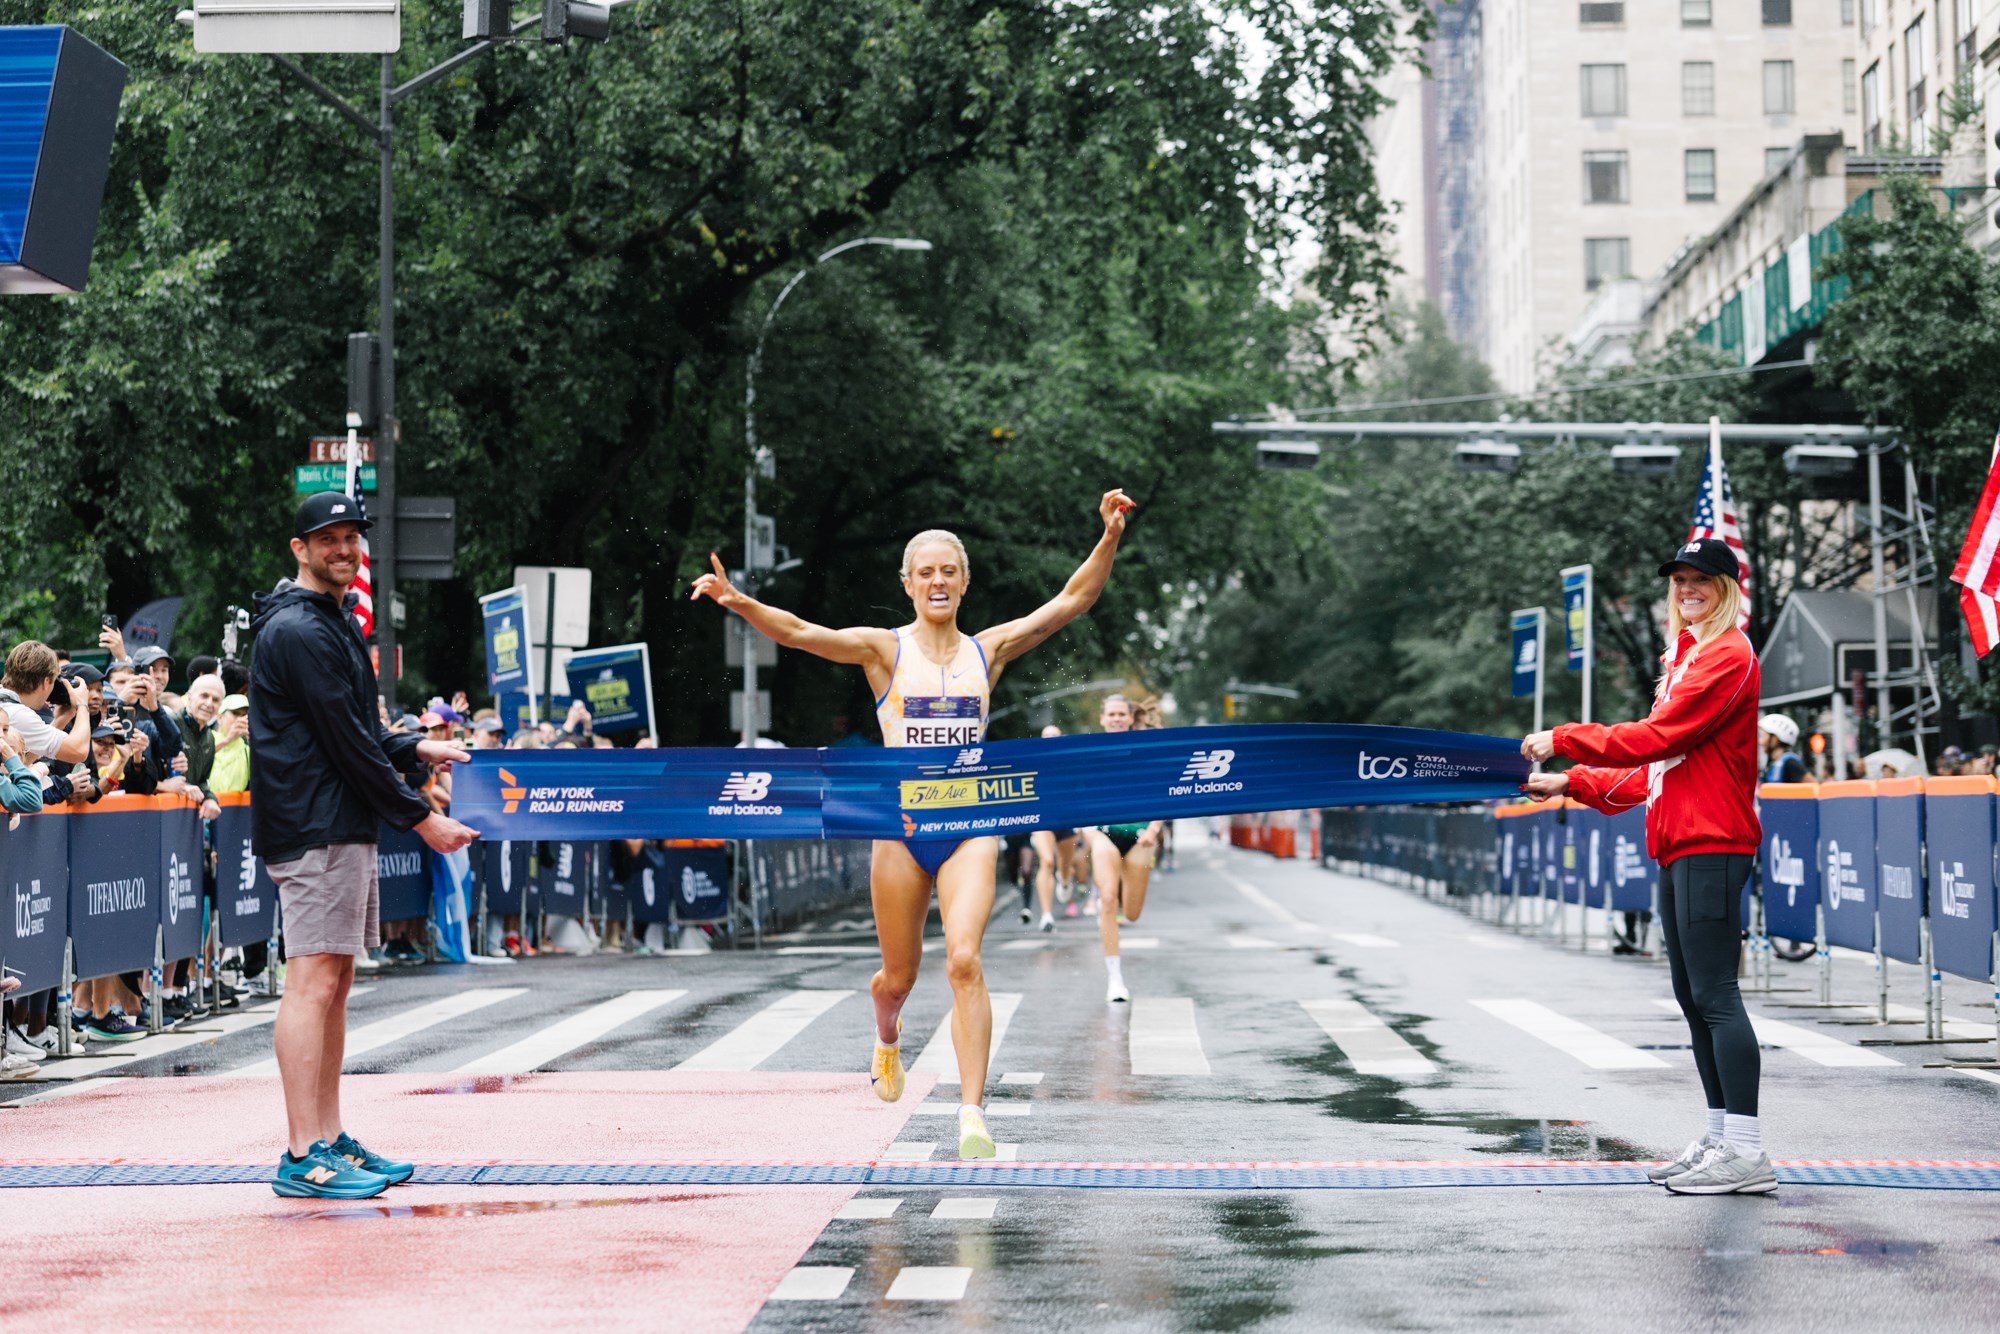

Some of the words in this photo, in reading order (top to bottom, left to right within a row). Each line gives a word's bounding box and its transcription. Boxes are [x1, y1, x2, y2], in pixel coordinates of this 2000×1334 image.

[316, 442, 326, 461] E
[906, 726, 978, 745] REEKIE
[1357, 750, 1409, 780] tcs
[1413, 761, 1489, 773] CONSULTANCY
[1415, 755, 1448, 763] TATA
[947, 766, 961, 775] new
[961, 764, 989, 773] balance
[1412, 768, 1460, 779] SERVICES
[529, 787, 560, 800] NEW
[560, 787, 595, 800] YORK
[909, 785, 939, 804] 5th
[981, 777, 1036, 800] MILE
[1168, 784, 1194, 796] new
[1194, 780, 1243, 795] balance
[529, 801, 565, 813] ROAD
[566, 799, 625, 813] RUNNERS
[708, 806, 733, 816] new
[734, 803, 783, 816] balance
[919, 823, 943, 832] NEW
[944, 821, 970, 831] YORK
[971, 818, 998, 829] ROAD
[998, 814, 1041, 827] RUNNERS
[87, 876, 146, 916] TIFFANY&CO.
[15, 882, 31, 938] tcs
